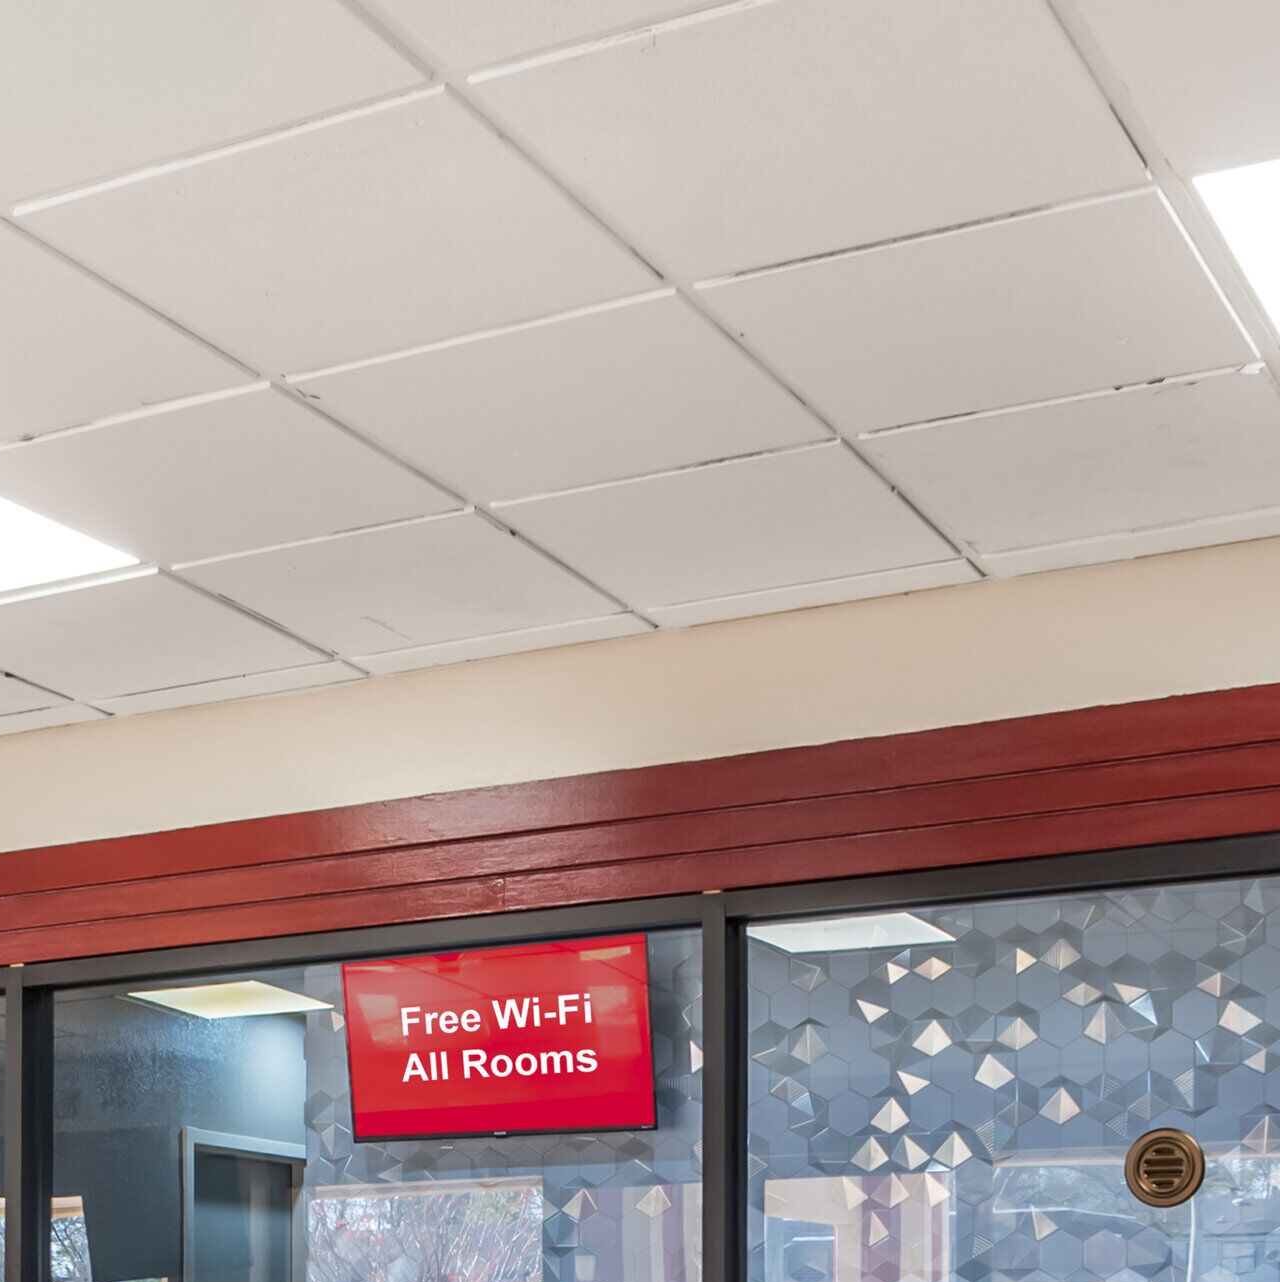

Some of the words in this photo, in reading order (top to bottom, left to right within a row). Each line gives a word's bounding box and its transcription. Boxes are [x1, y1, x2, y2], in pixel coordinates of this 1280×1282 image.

[401, 1006, 481, 1036] Free
[491, 993, 593, 1030] Wi-Fi
[402, 1051, 449, 1082] All
[462, 1049, 598, 1079] Rooms
